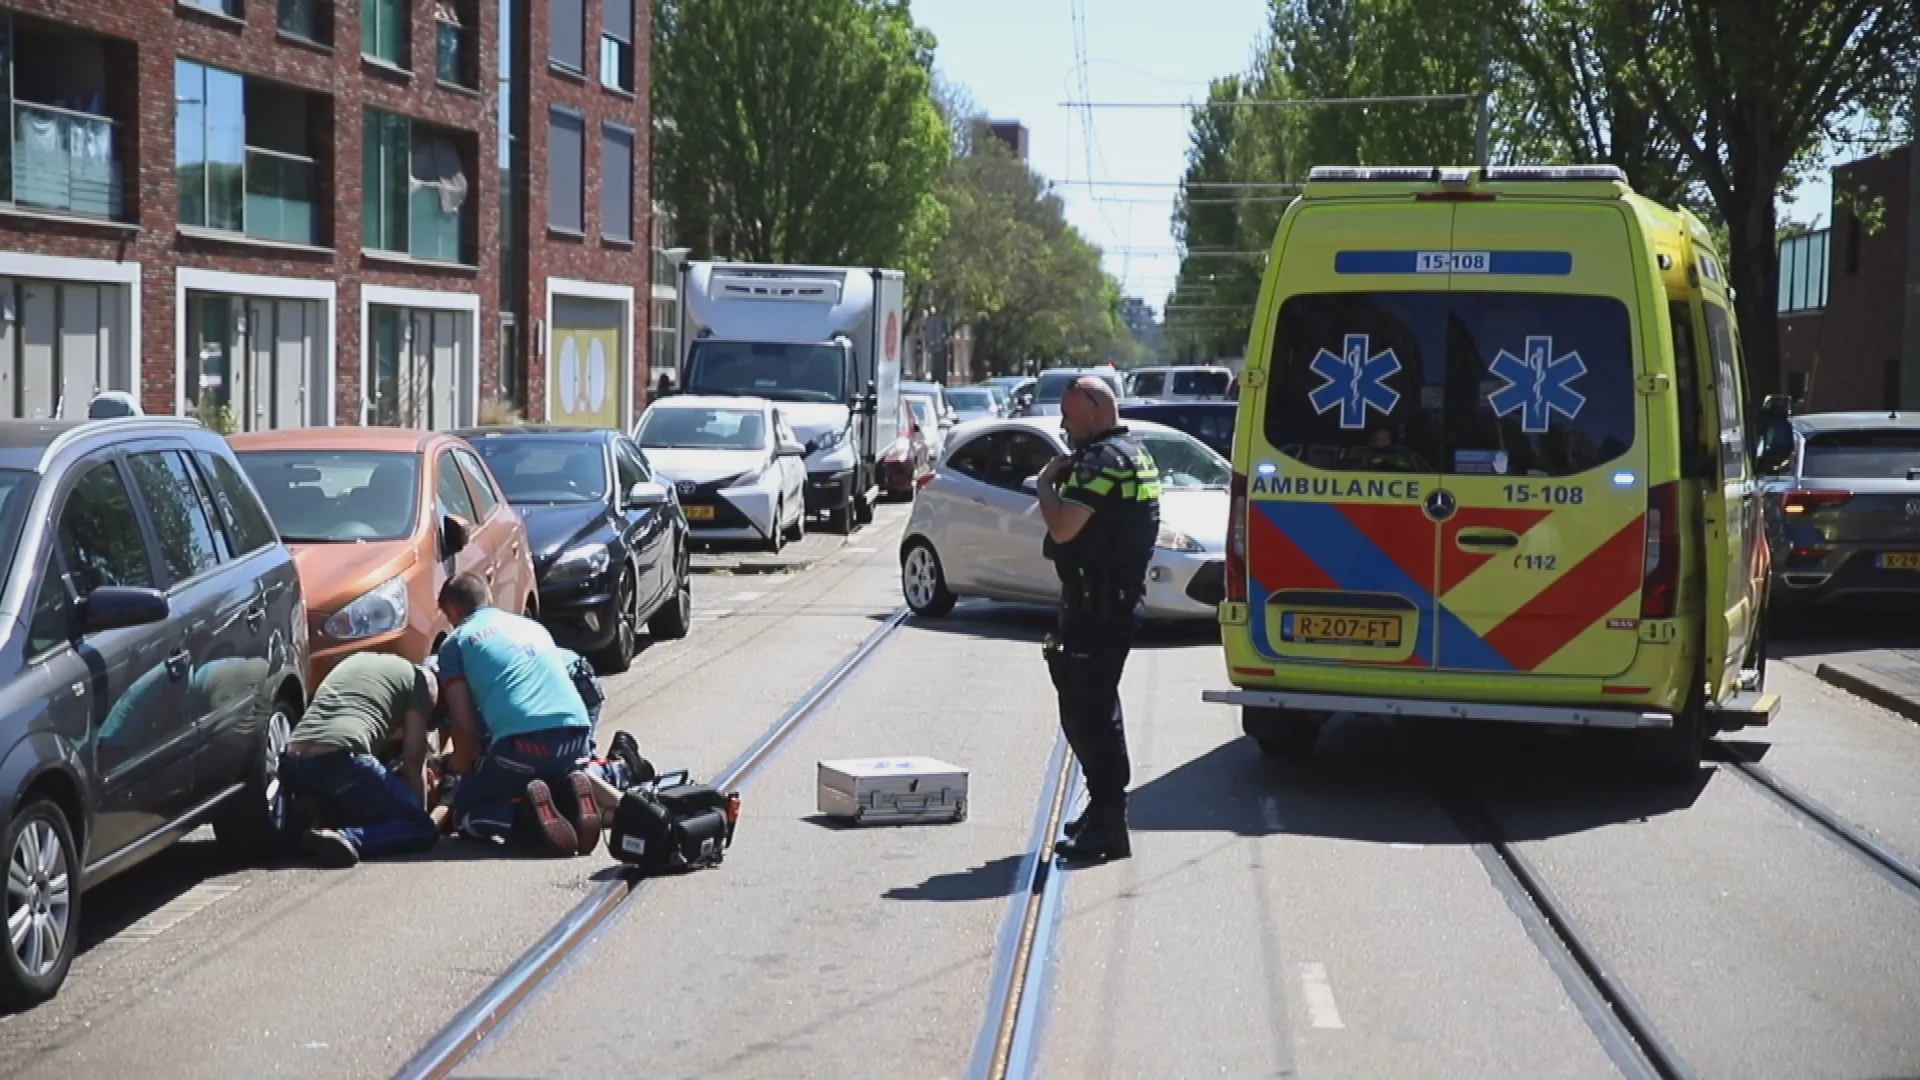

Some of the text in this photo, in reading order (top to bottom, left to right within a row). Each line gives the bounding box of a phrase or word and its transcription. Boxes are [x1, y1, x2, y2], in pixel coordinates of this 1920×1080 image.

[1422, 255, 1485, 269] 15-108
[1251, 477, 1420, 499] AMBULANCE
[1502, 484, 1584, 505] 15-108
[1300, 617, 1392, 639] R-207-FT
